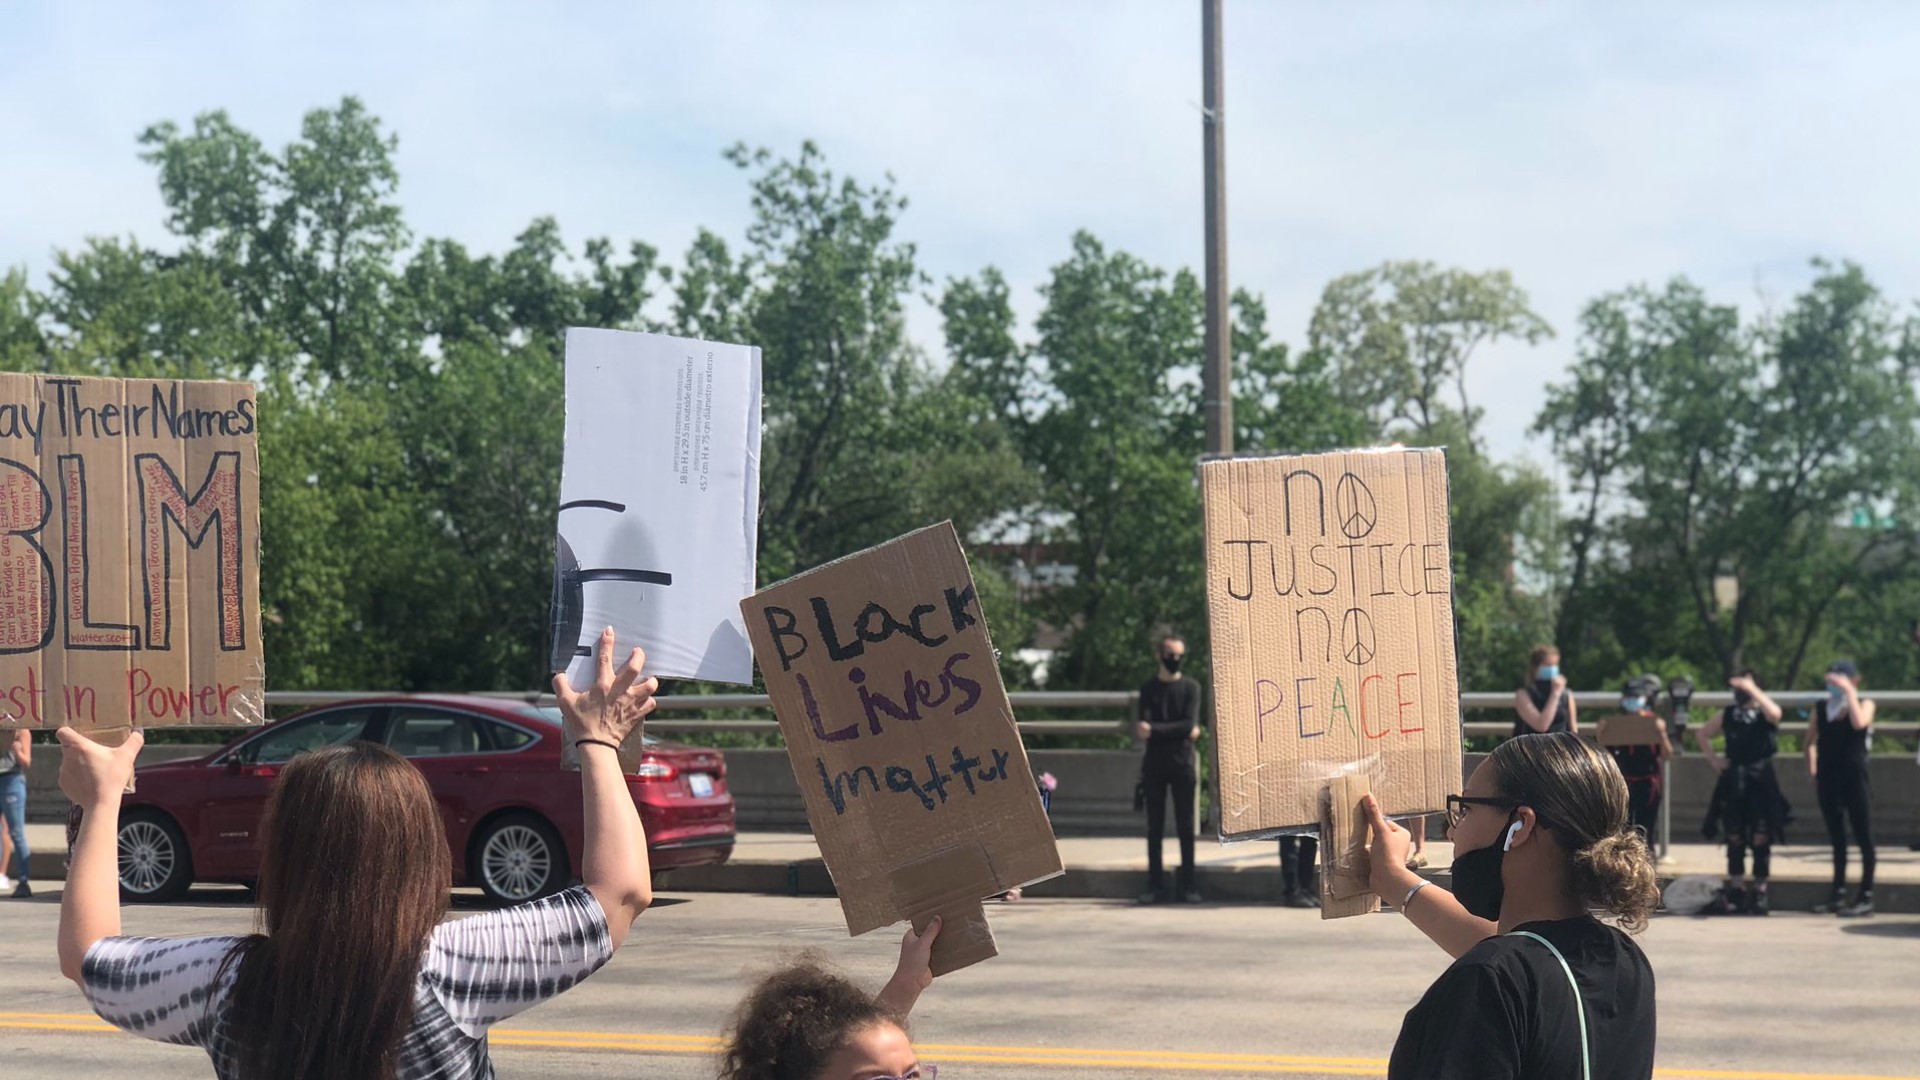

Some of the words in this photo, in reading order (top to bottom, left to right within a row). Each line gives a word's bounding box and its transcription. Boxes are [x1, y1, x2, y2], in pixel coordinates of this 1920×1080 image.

[683, 355, 693, 391] diameter
[705, 352, 714, 383] externo
[682, 392, 692, 422] outside
[0, 401, 46, 456] ay
[46, 379, 149, 438] Their
[682, 423, 690, 432] in
[704, 421, 711, 434] cm
[681, 432, 690, 449] 29.5
[701, 435, 710, 445] 75
[681, 456, 689, 465] H
[702, 461, 709, 474] cm
[681, 465, 688, 475] in
[680, 475, 689, 485] 18
[63, 683, 96, 723] in
[128, 668, 240, 723] Power
[1256, 673, 1424, 743] PEACE
